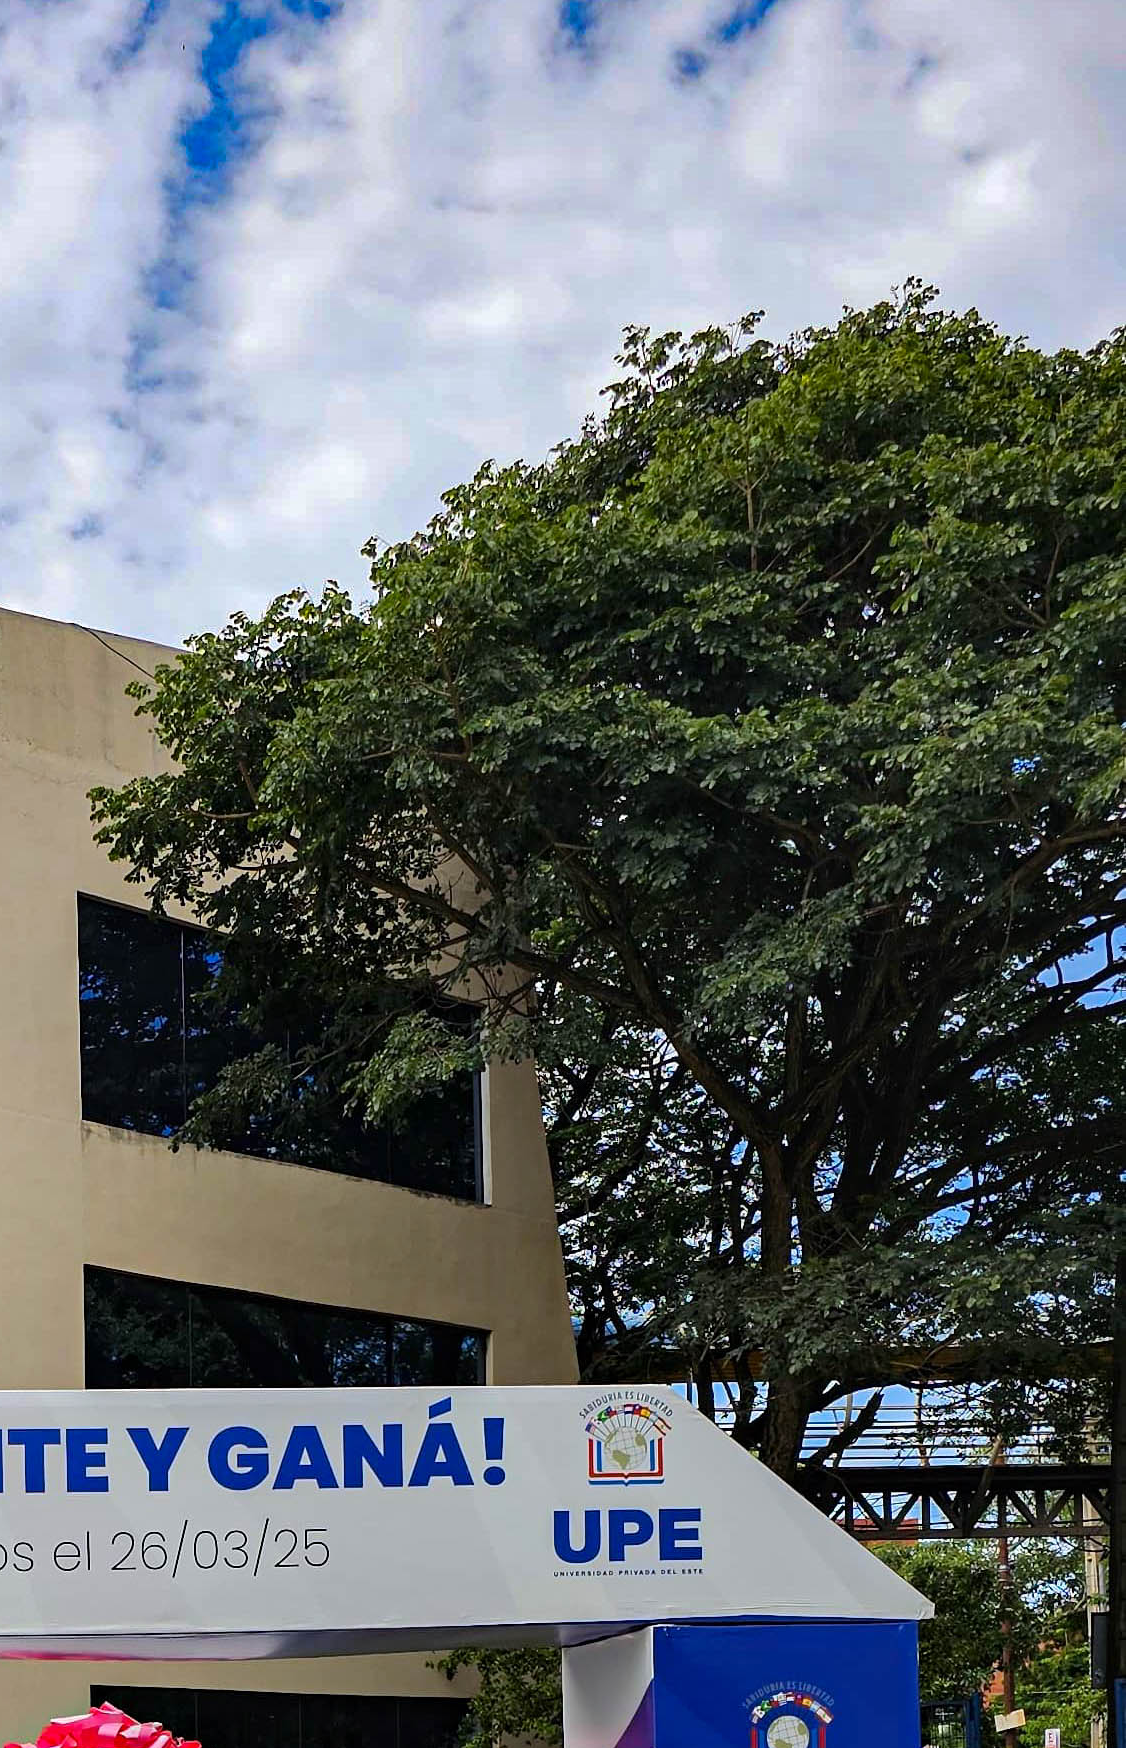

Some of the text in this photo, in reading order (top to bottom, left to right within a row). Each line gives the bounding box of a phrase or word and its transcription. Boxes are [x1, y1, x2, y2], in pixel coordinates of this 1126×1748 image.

[579, 1391, 673, 1419] SABIDURIA ES LIBERTAD
[126, 1427, 190, 1492] Y
[207, 1396, 506, 1491] GANÁ!
[53, 1530, 91, 1572] el
[110, 1517, 330, 1579] 26/03/25
[553, 1508, 703, 1564] UPE
